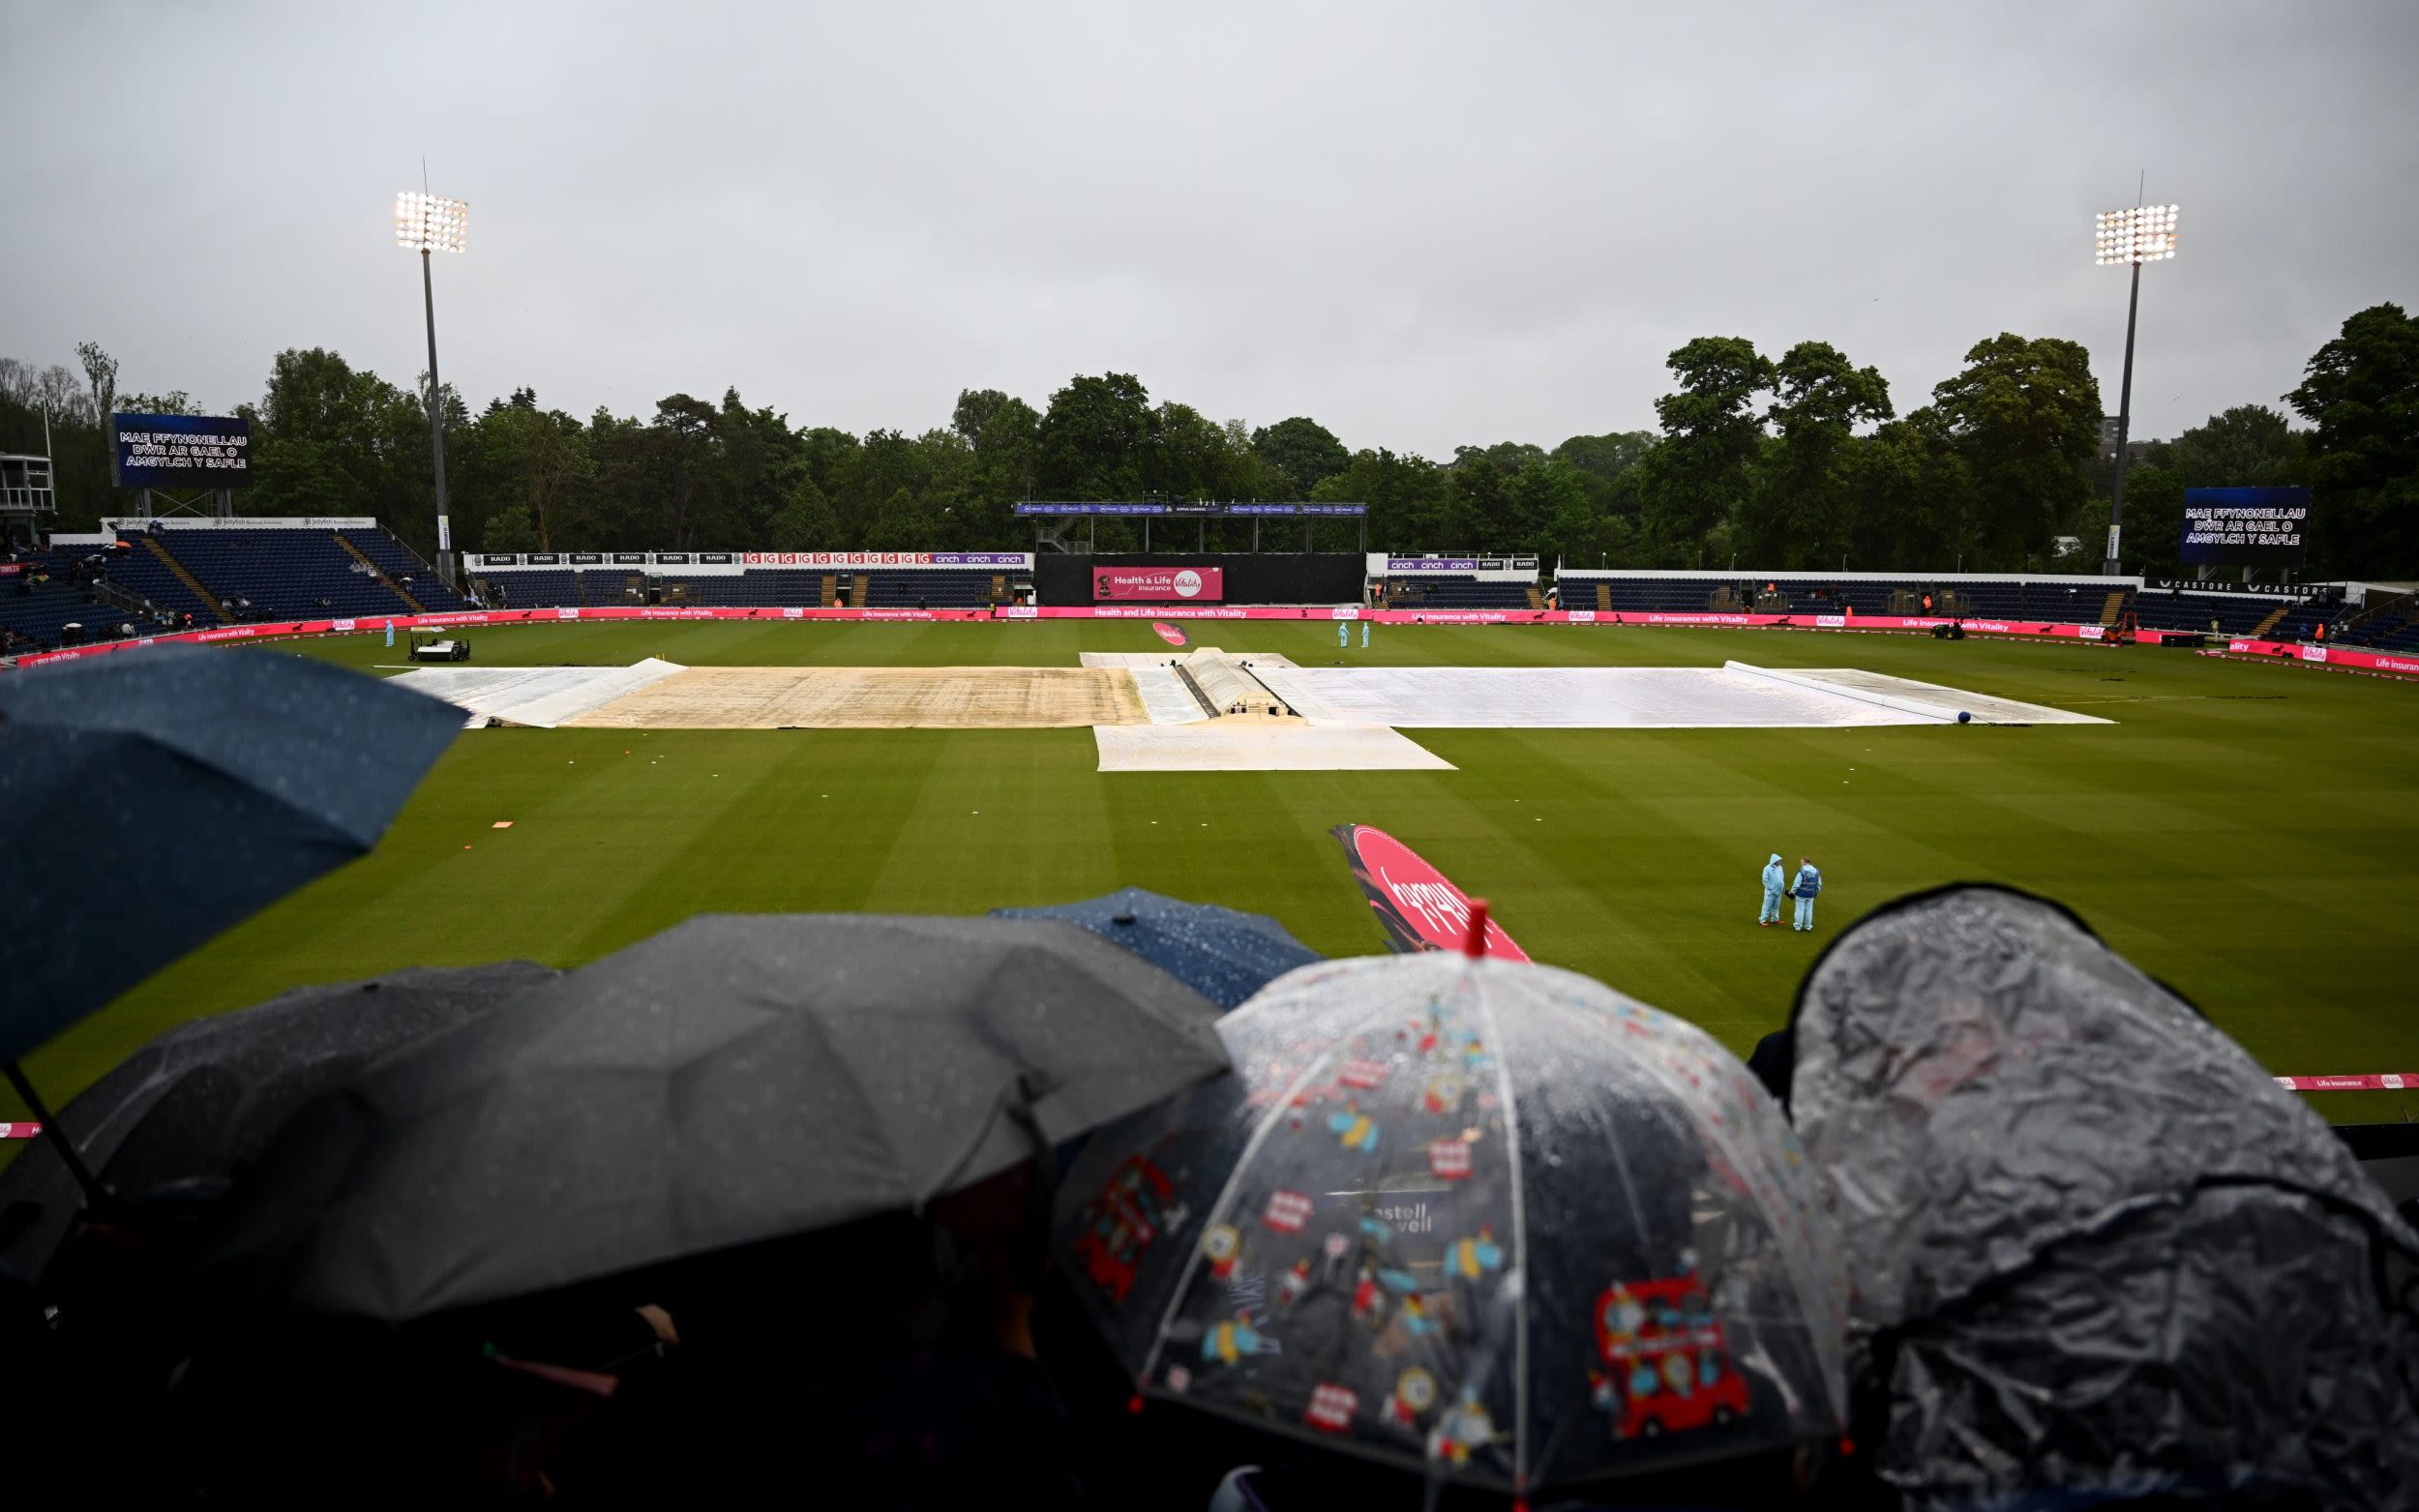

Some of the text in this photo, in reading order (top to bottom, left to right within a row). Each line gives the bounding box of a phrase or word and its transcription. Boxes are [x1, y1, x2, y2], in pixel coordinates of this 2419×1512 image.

[120, 432, 247, 446] MAE FFYNONELLAU
[169, 446, 188, 456] AR
[191, 446, 224, 457] GAEL
[226, 447, 237, 457] O
[126, 457, 247, 468] AMGYLCH Y SAFLE
[2186, 508, 2306, 519] MAE FFYNONELLAU
[2225, 521, 2243, 531] AR
[2246, 521, 2279, 531] GAEL
[2282, 521, 2292, 532] O
[2187, 533, 2300, 545] AMGYLCH Y SAFLE
[747, 554, 759, 563] IG
[764, 554, 776, 563] IG
[782, 554, 793, 563] IG
[799, 554, 810, 563] IG
[817, 554, 827, 563] IG
[834, 554, 845, 563] IG
[851, 554, 862, 563] IG
[868, 554, 879, 563] IG
[884, 554, 896, 563] IG
[902, 554, 912, 563] IG
[918, 554, 930, 563] IG
[936, 554, 959, 563] cinch
[967, 554, 991, 563] cinch
[998, 554, 1022, 563] cinch
[1176, 578, 1200, 590] Vitality
[2175, 580, 2231, 591] CASTORE
[1217, 608, 1247, 618] Vitality
[1479, 613, 1506, 622] Vitality
[1570, 611, 1594, 621] Vitality
[1980, 623, 2009, 633] Vitality
[2229, 641, 2250, 652] ality
[2304, 645, 2325, 660] Vitality
[2376, 659, 2419, 670] Life insuran
